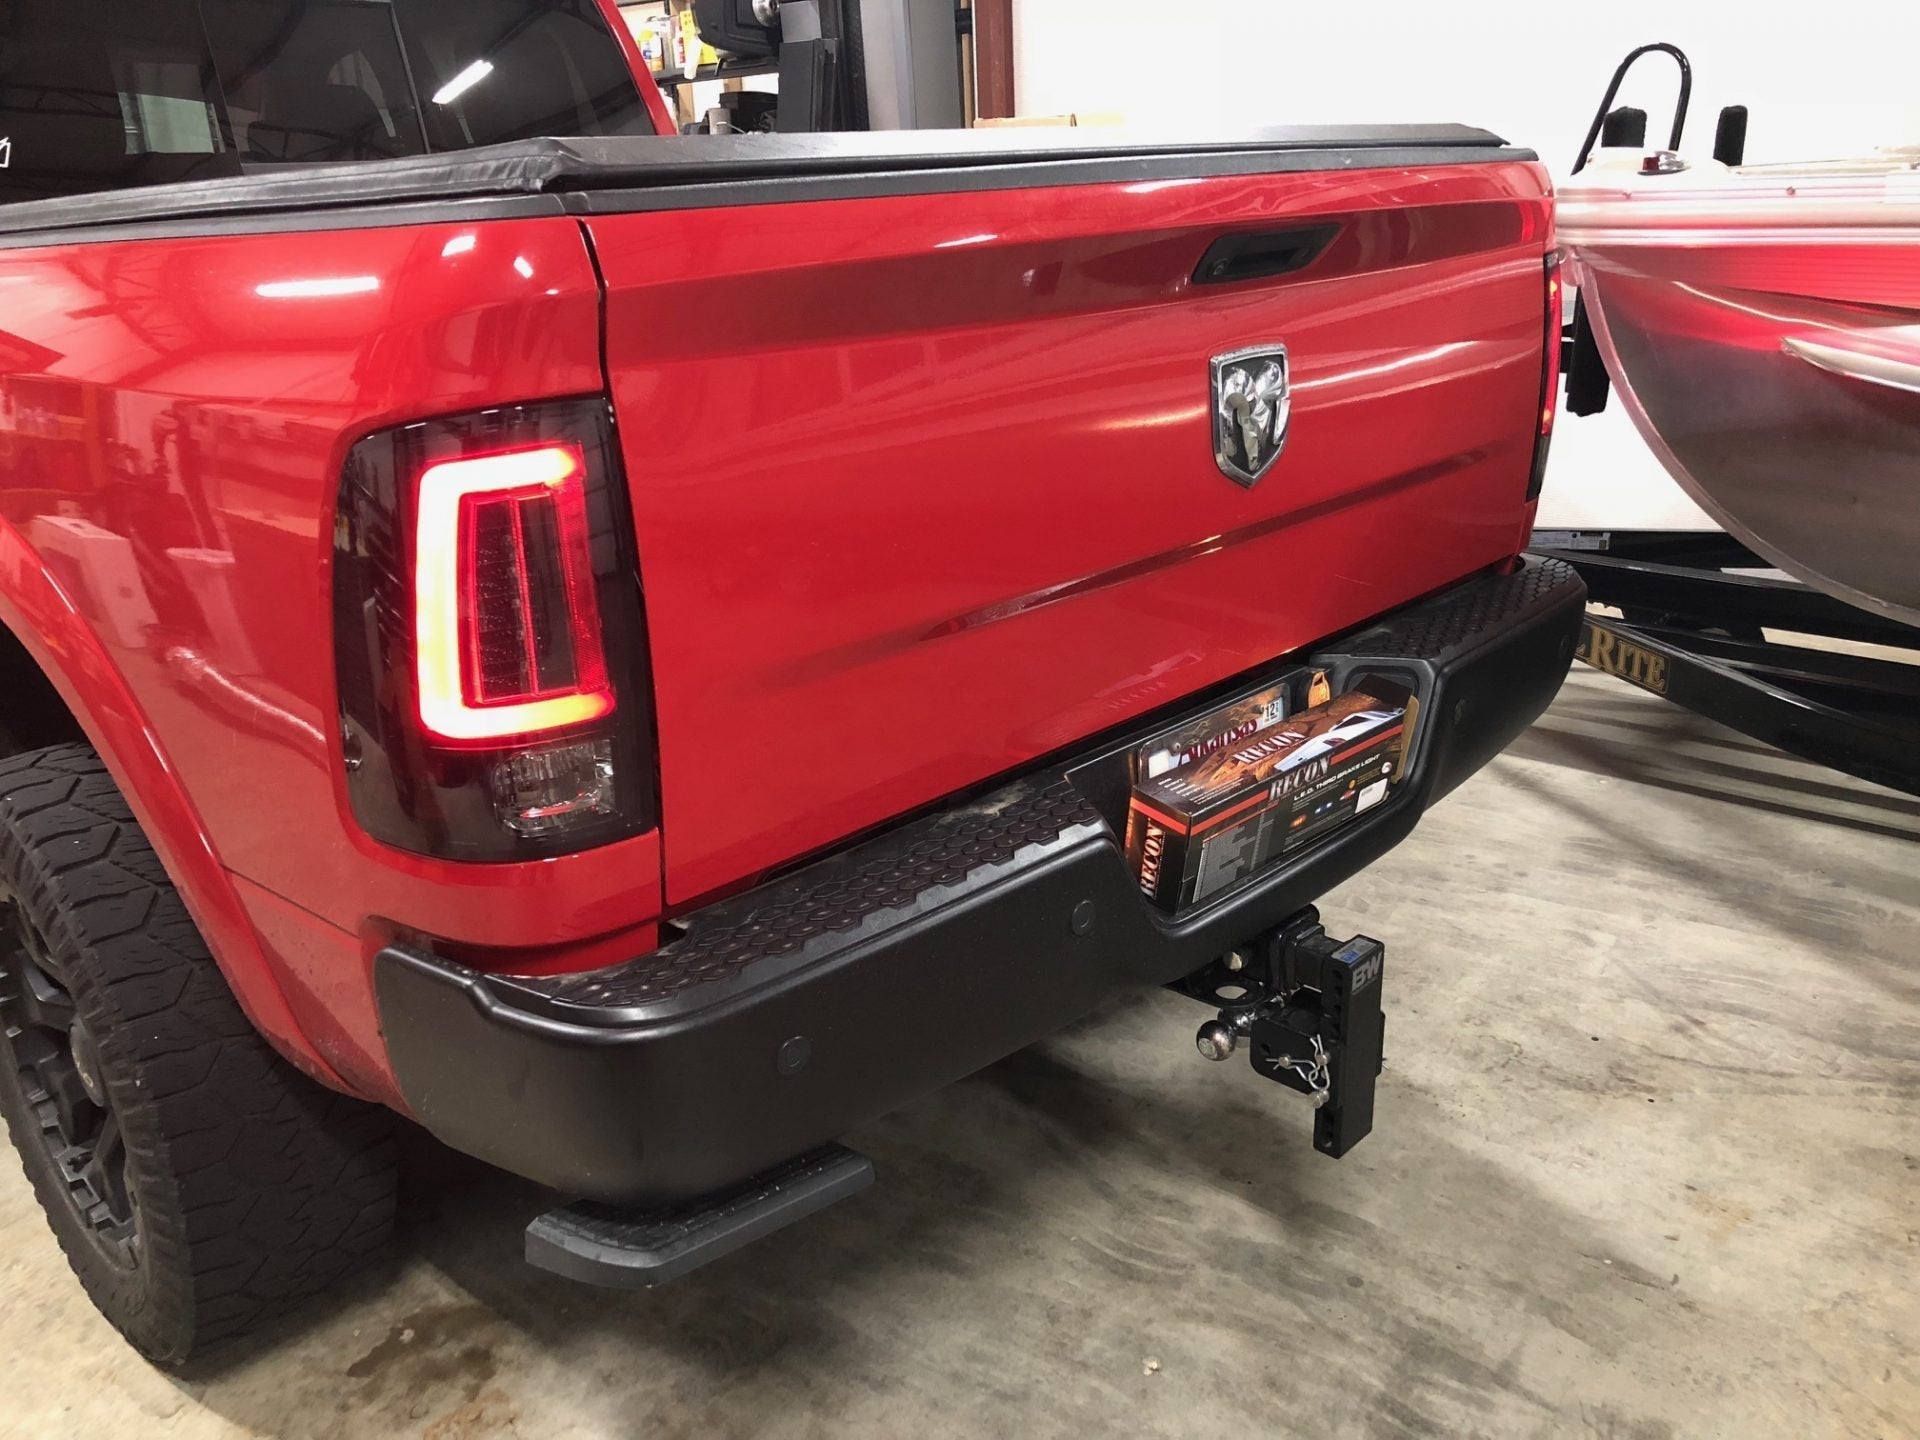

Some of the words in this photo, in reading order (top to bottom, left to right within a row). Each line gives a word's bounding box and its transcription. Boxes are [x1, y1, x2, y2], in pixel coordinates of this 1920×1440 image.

[1586, 626, 1665, 690] RITE
[1232, 729, 1306, 763] RECON
[1269, 753, 1333, 801] RECON
[1140, 817, 1163, 899] RECON
